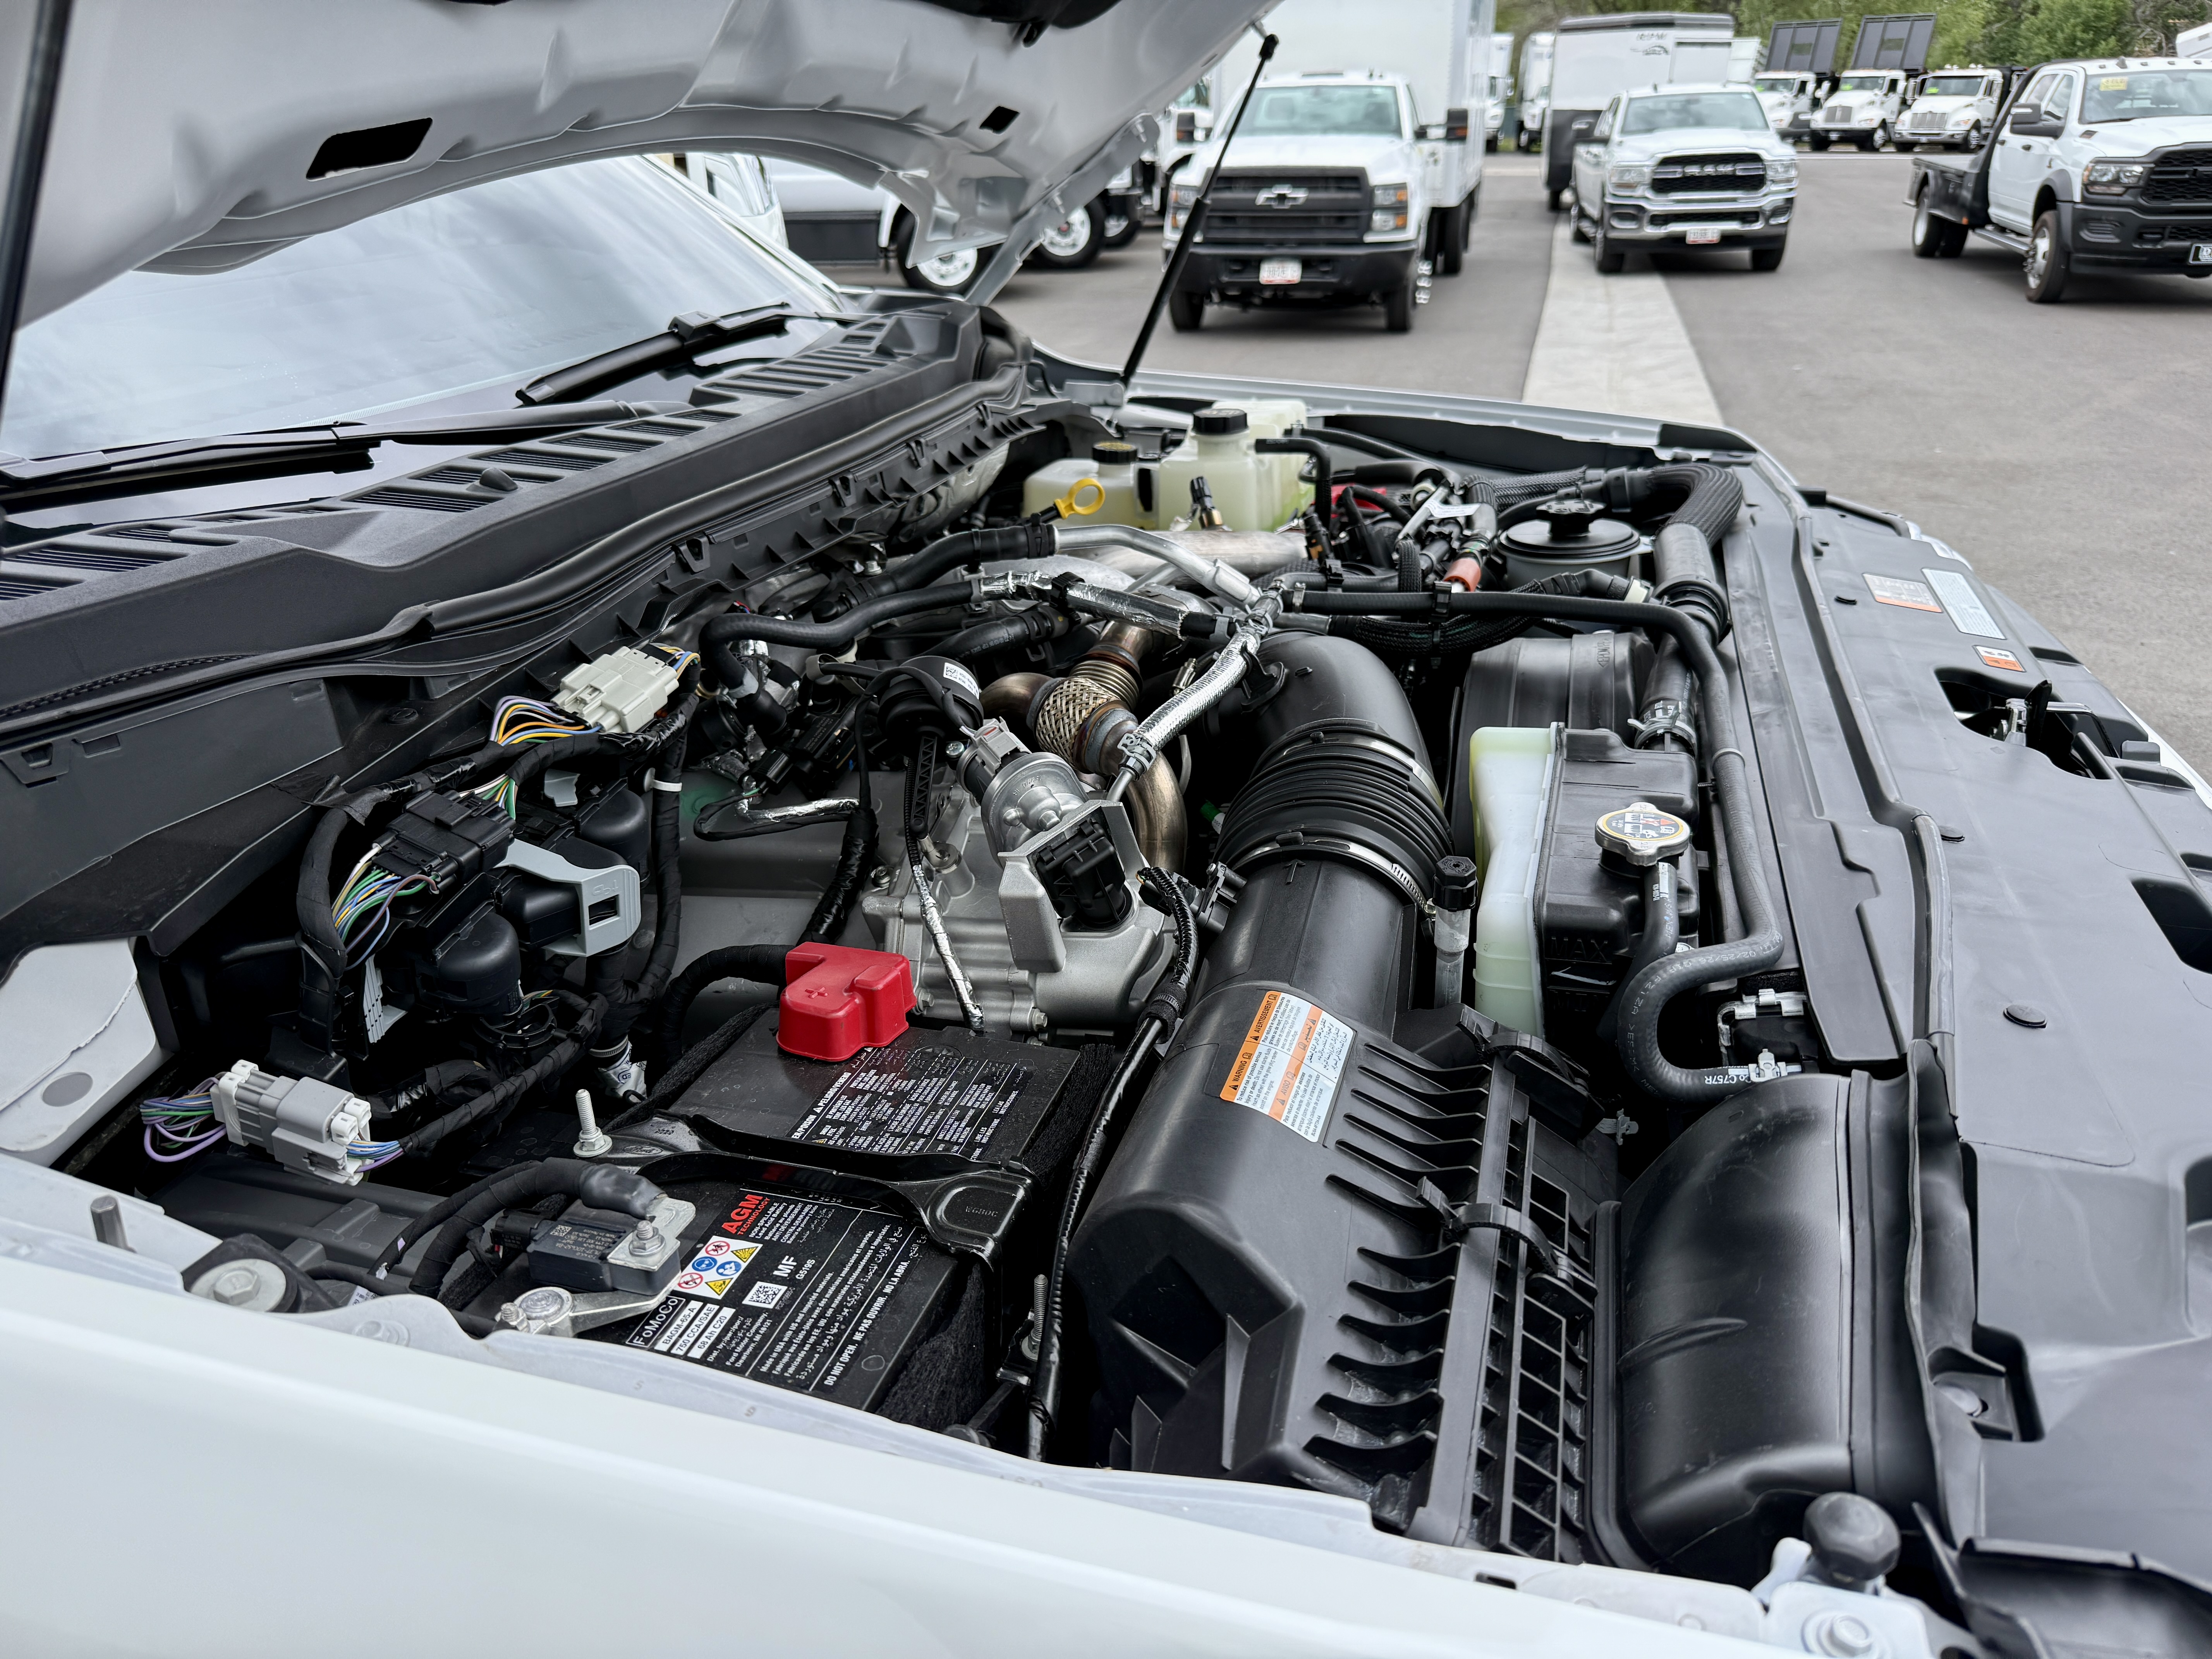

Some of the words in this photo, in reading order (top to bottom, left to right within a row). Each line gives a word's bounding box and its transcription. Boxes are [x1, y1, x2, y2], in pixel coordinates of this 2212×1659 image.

[1254, 1000, 1273, 1033] AVERTISSEMENT
[1232, 1060, 1247, 1082] WARNING
[1249, 1063, 1257, 1076] possible
[1705, 1075, 1737, 1085] C757R
[1280, 1080, 1291, 1096] AVISO
[792, 1115, 816, 1139] ER/POISON
[818, 1072, 851, 1106] PELIGRO/VENENO
[999, 1091, 1018, 1114] INSTRUCCIONES.
[974, 1134, 983, 1142] LIRE
[981, 1118, 1000, 1143] INSTRUCTIONS.
[722, 1195, 762, 1233] AGM
[737, 1198, 769, 1235] TECHNOLOGY
[749, 1203, 779, 1237] NON-SPILLABLE
[755, 1227, 767, 1238] Lead
[764, 1217, 775, 1227] Acid
[771, 1202, 787, 1218] Battery
[764, 1223, 780, 1240] Batterie
[783, 1204, 795, 1218] plomb
[772, 1231, 783, 1241] ANTI
[779, 1203, 803, 1231] DÉVERSEMENT
[780, 1226, 797, 1242] CONTRA
[793, 1204, 812, 1226] DERRAMES
[800, 1216, 810, 1228] plomo
[893, 1227, 902, 1237] صنع
[875, 1243, 891, 1263] الولايات
[773, 1255, 797, 1277] MF
[796, 1259, 815, 1279] G519S
[860, 1264, 878, 1282] المتحدة
[894, 1261, 910, 1277] ABRA.
[806, 1336, 817, 1344] los
[812, 1328, 822, 1336] EE.
[817, 1317, 828, 1327] UU.
[825, 1308, 834, 1317] con
[831, 1285, 850, 1308] materiales
[847, 1250, 873, 1285] estadounidenses
[871, 1224, 891, 1246] importados.
[843, 1283, 865, 1307] الأمريكية
[883, 1285, 894, 1293] NO
[772, 1353, 792, 1374] Fabriqué
[788, 1343, 798, 1353] aux
[793, 1318, 814, 1343] États-Unis
[811, 1307, 822, 1318] avec
[818, 1298, 828, 1307] des
[825, 1277, 843, 1298] matériaux
[840, 1254, 859, 1277] américains
[858, 1230, 874, 1249] importés.
[867, 1296, 888, 1319] OUVRIR.
[633, 1298, 678, 1345] FoMoCo
[760, 1358, 774, 1372] Made
[774, 1342, 786, 1352] USA
[783, 1330, 793, 1341] with
[795, 1313, 805, 1322] and
[800, 1292, 819, 1313] imported
[816, 1272, 834, 1293] materials.
[836, 1307, 852, 1321] بمواد
[858, 1319, 872, 1331] PAS
[662, 1308, 696, 1344] BAGM-65-A
[676, 1339, 690, 1351] 750
[687, 1307, 715, 1338] CCA/SAE
[697, 1341, 708, 1349] 68
[705, 1331, 717, 1340] Ah
[713, 1316, 727, 1329] C20
[825, 1322, 840, 1334] منها
[852, 1331, 865, 1341] NE
[725, 1352, 738, 1365] Ford
[735, 1337, 749, 1352] Motor
[746, 1312, 768, 1337] Company,
[735, 1342, 757, 1367] Dearborn,
[759, 1319, 773, 1334] 48121
[816, 1335, 834, 1353] ومواد
[707, 1350, 720, 1362] Dist.
[840, 1344, 858, 1362] OPEN.
[796, 1353, 819, 1379] مستوردة
[830, 1362, 845, 1376] NOT
[824, 1376, 837, 1386] DO
